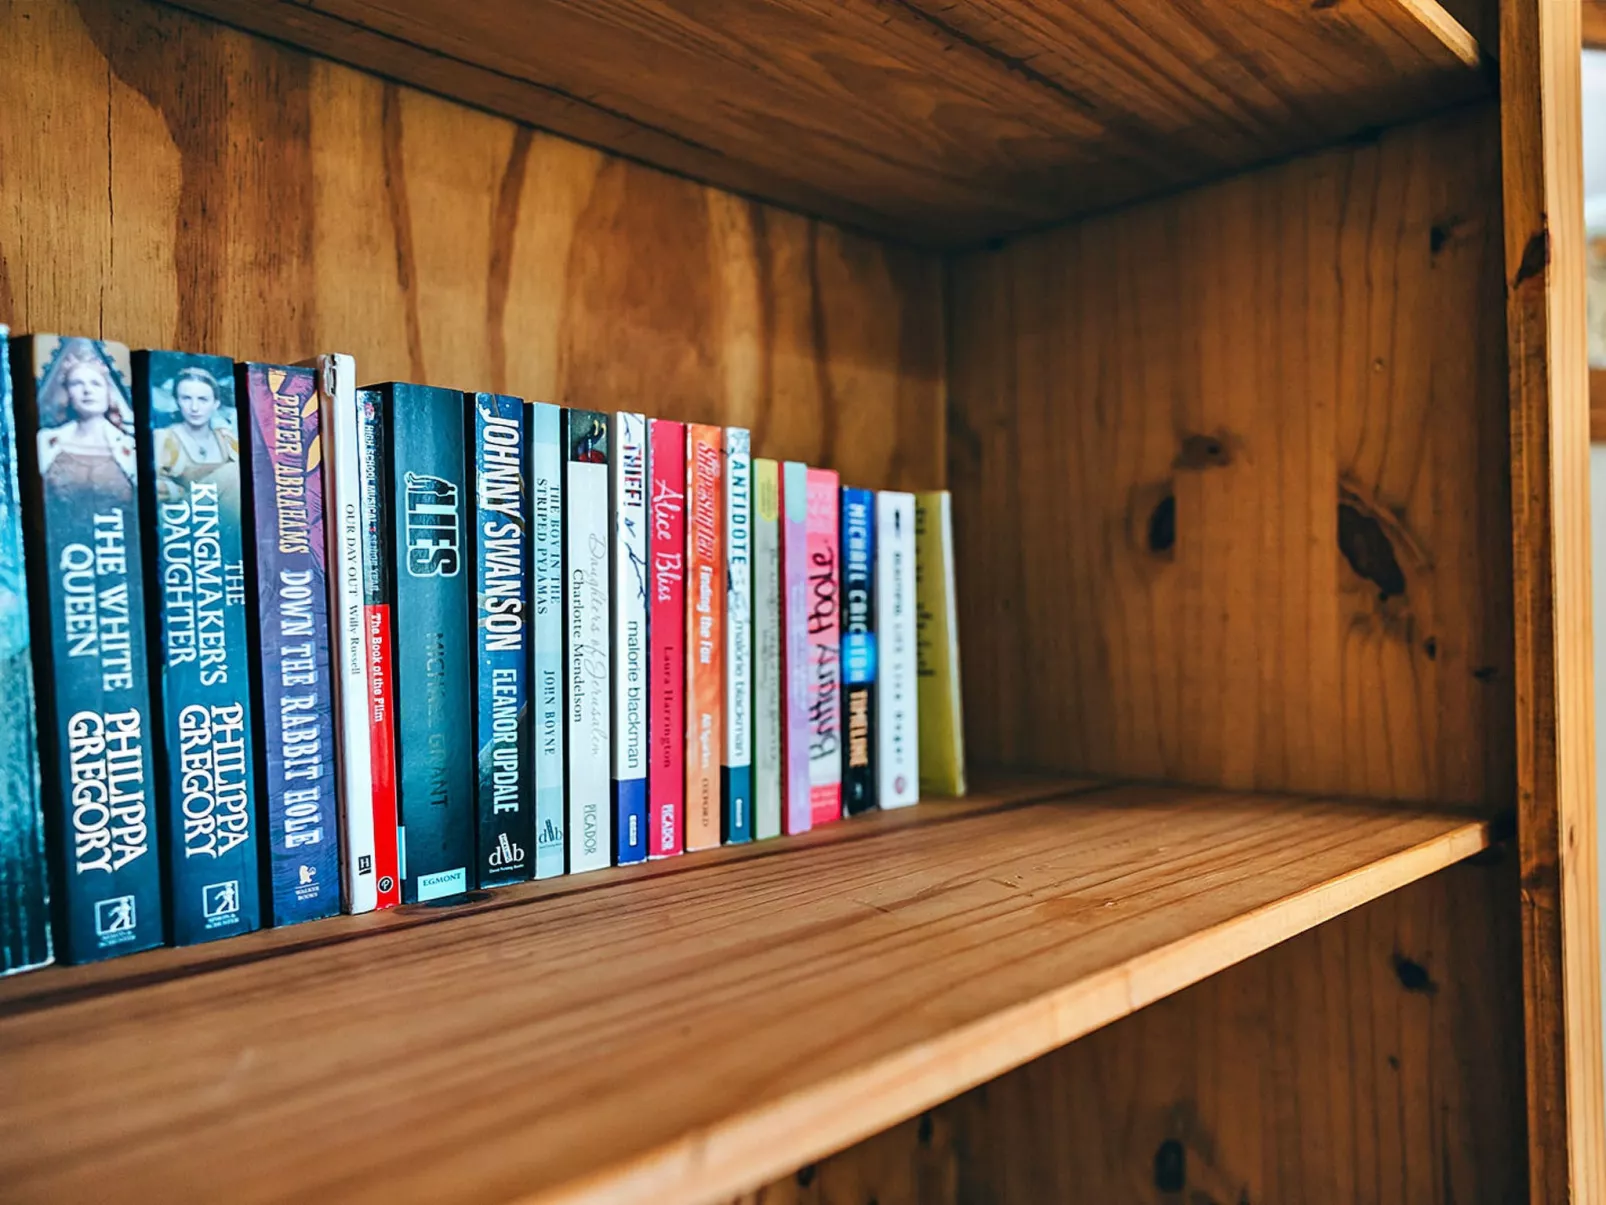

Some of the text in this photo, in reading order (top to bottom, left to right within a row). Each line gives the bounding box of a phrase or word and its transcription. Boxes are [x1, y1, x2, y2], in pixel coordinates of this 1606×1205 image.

[273, 393, 311, 555] PETER ABRAHAMS
[364, 425, 375, 446] HIGH
[365, 448, 376, 482] SCHOOL
[622, 444, 643, 508] THIEF!
[367, 485, 377, 524] MUSICAL
[369, 534, 379, 566] SENIOR
[406, 488, 460, 577] LIES
[476, 395, 523, 652] JOHNNY SWANSON
[536, 478, 548, 615] STRIPED PYJAMAS
[549, 485, 562, 604] THE BOY IN THE
[651, 479, 684, 603] Alice Bliss
[730, 460, 747, 565] ANTIDOTE
[848, 503, 868, 581] MICHAEL
[60, 543, 99, 658] QUEEN
[93, 508, 134, 692] THE WHITE
[161, 500, 197, 668] DAUGHTER
[190, 481, 228, 687] KINGMAKER'S
[224, 560, 246, 606] THE
[346, 504, 361, 675] OUR DAY OUT Willy Russell
[587, 533, 607, 635] Daughters
[696, 565, 714, 612] Finding
[699, 614, 713, 638] the
[370, 613, 385, 723] The Book of the Film
[572, 568, 586, 723] Charlotte Mendelson
[627, 620, 641, 769] malorie blackman
[699, 640, 714, 665] Fox
[734, 620, 748, 757] malorie blackman
[279, 569, 324, 849] DOWN THE RABBIT HOLE
[492, 668, 519, 815] ELEANOR UPDALE
[543, 670, 556, 756] JOHN BOYNE
[584, 658, 608, 758] Jerusalem
[660, 646, 675, 768] Laura Harrington
[849, 689, 868, 768] TIMELINE
[68, 710, 114, 876] GREGORY
[104, 707, 149, 872] PHILIPPA
[178, 704, 217, 860] GREGORY
[211, 702, 250, 857] PHILIPPA
[428, 733, 449, 808] GRANT
[421, 872, 463, 887] EGMONT
[583, 803, 597, 855] PICADOR
[660, 803, 675, 851] PICADOR
